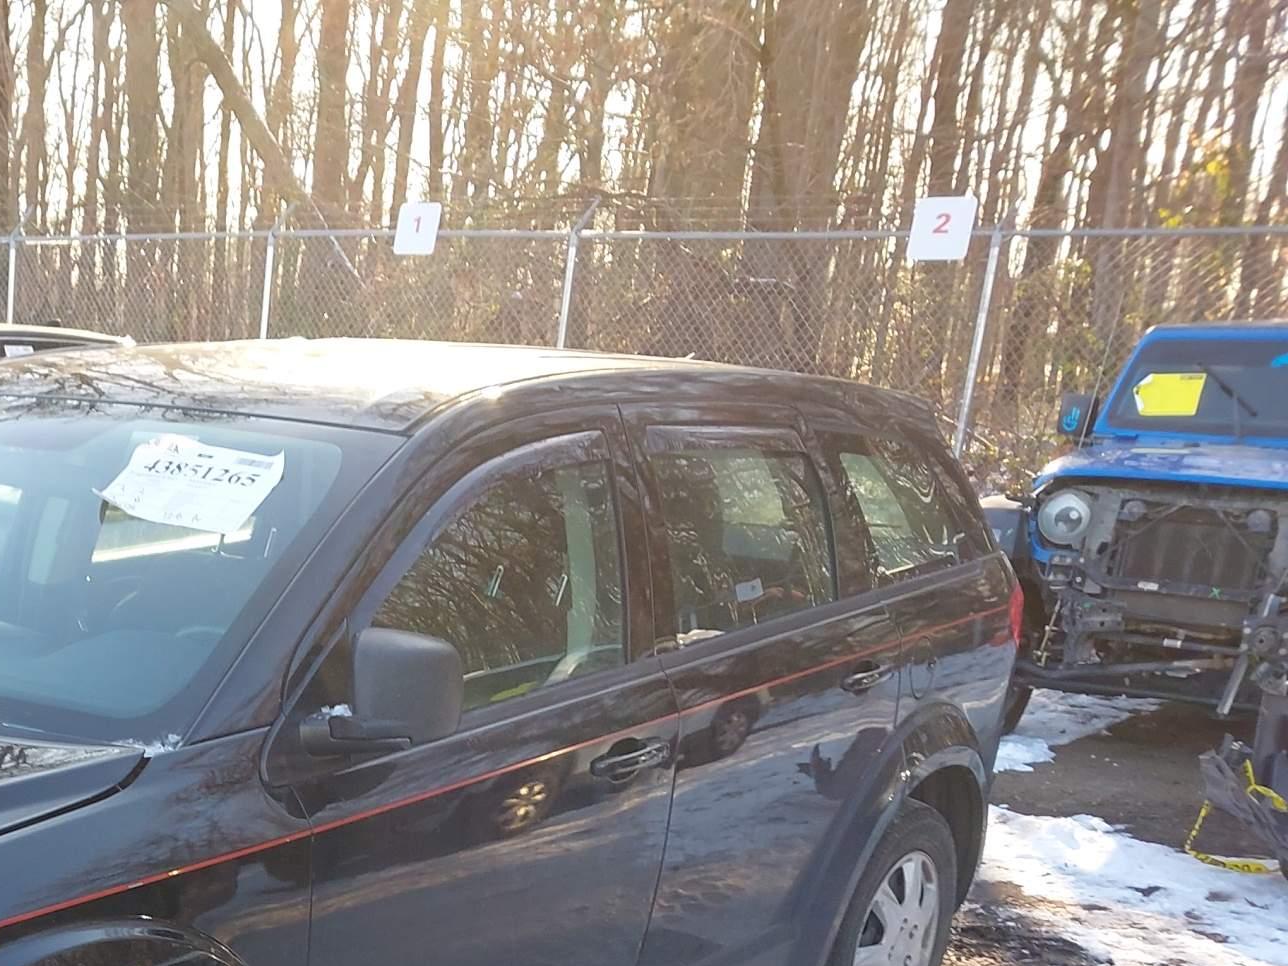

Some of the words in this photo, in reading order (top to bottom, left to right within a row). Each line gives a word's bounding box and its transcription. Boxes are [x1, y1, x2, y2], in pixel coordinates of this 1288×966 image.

[414, 215, 423, 234] 1
[931, 212, 952, 235] 2
[143, 458, 262, 488] 43851265
